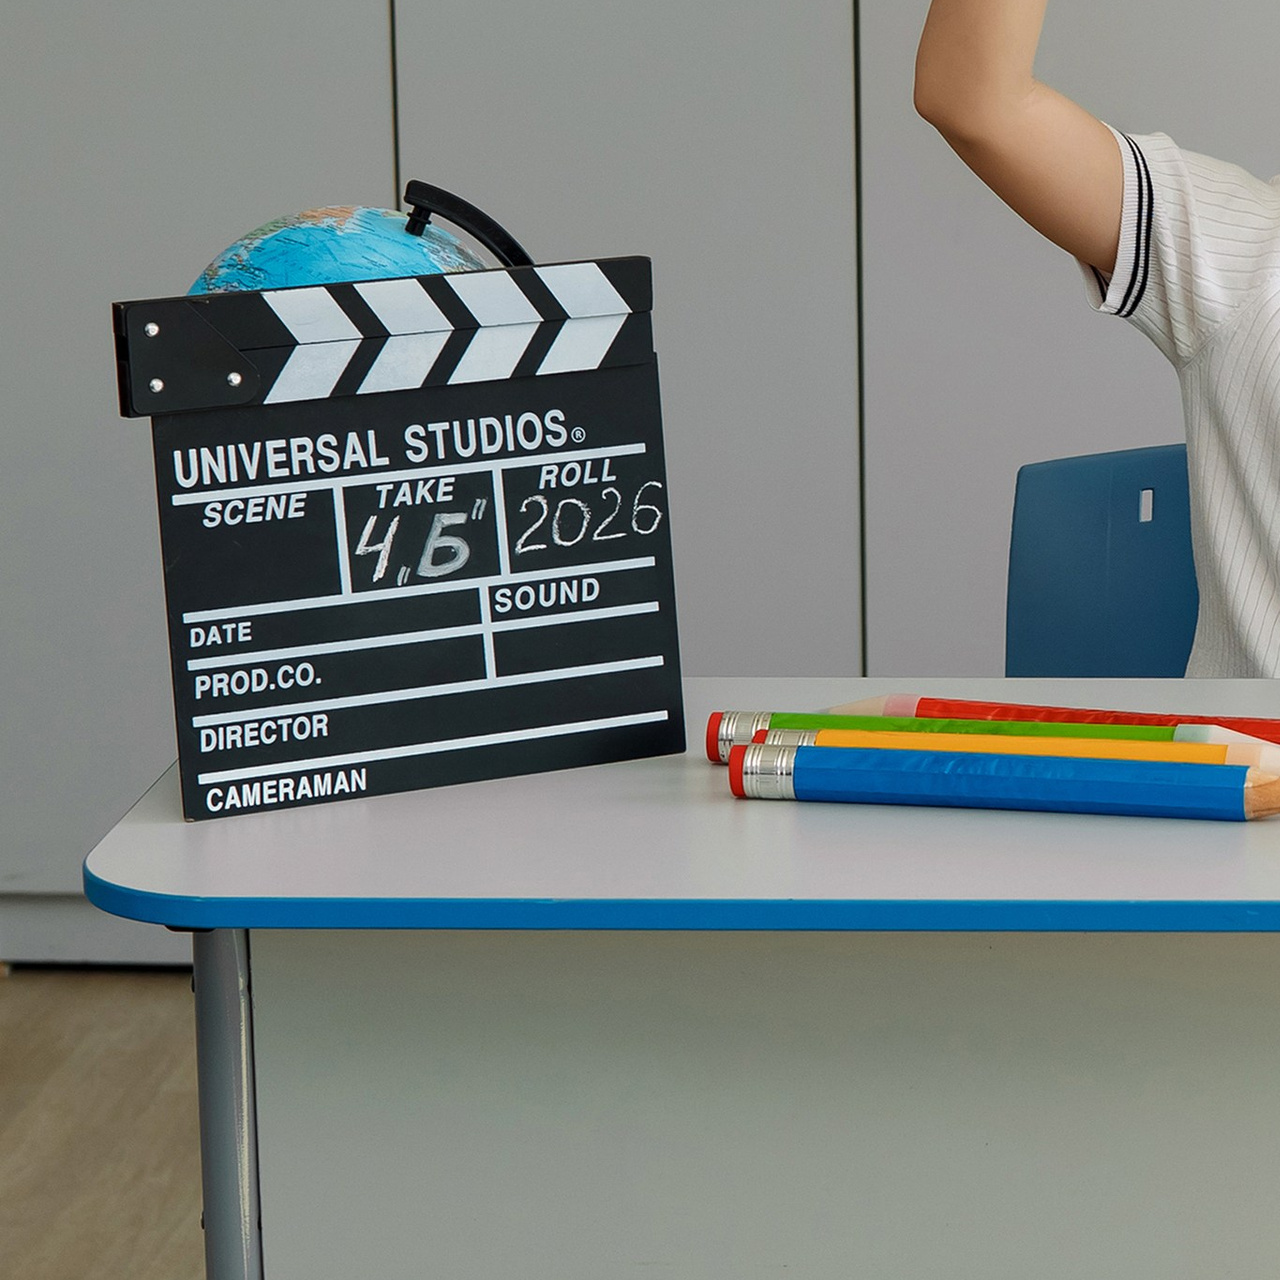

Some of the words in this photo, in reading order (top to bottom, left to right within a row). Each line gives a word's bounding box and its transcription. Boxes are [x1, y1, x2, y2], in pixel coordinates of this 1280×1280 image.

[173, 429, 390, 489] UNIVERSAL
[538, 458, 618, 490] ROLL
[202, 493, 307, 528] SCENE
[375, 477, 456, 510] TAKE
[515, 481, 663, 555] 2026
[494, 577, 601, 614] SOUND
[190, 621, 252, 648] DATE
[195, 662, 322, 700] PROD.CO.
[200, 713, 329, 753] DIRECTOR
[206, 767, 367, 812] CAMERAMAN
